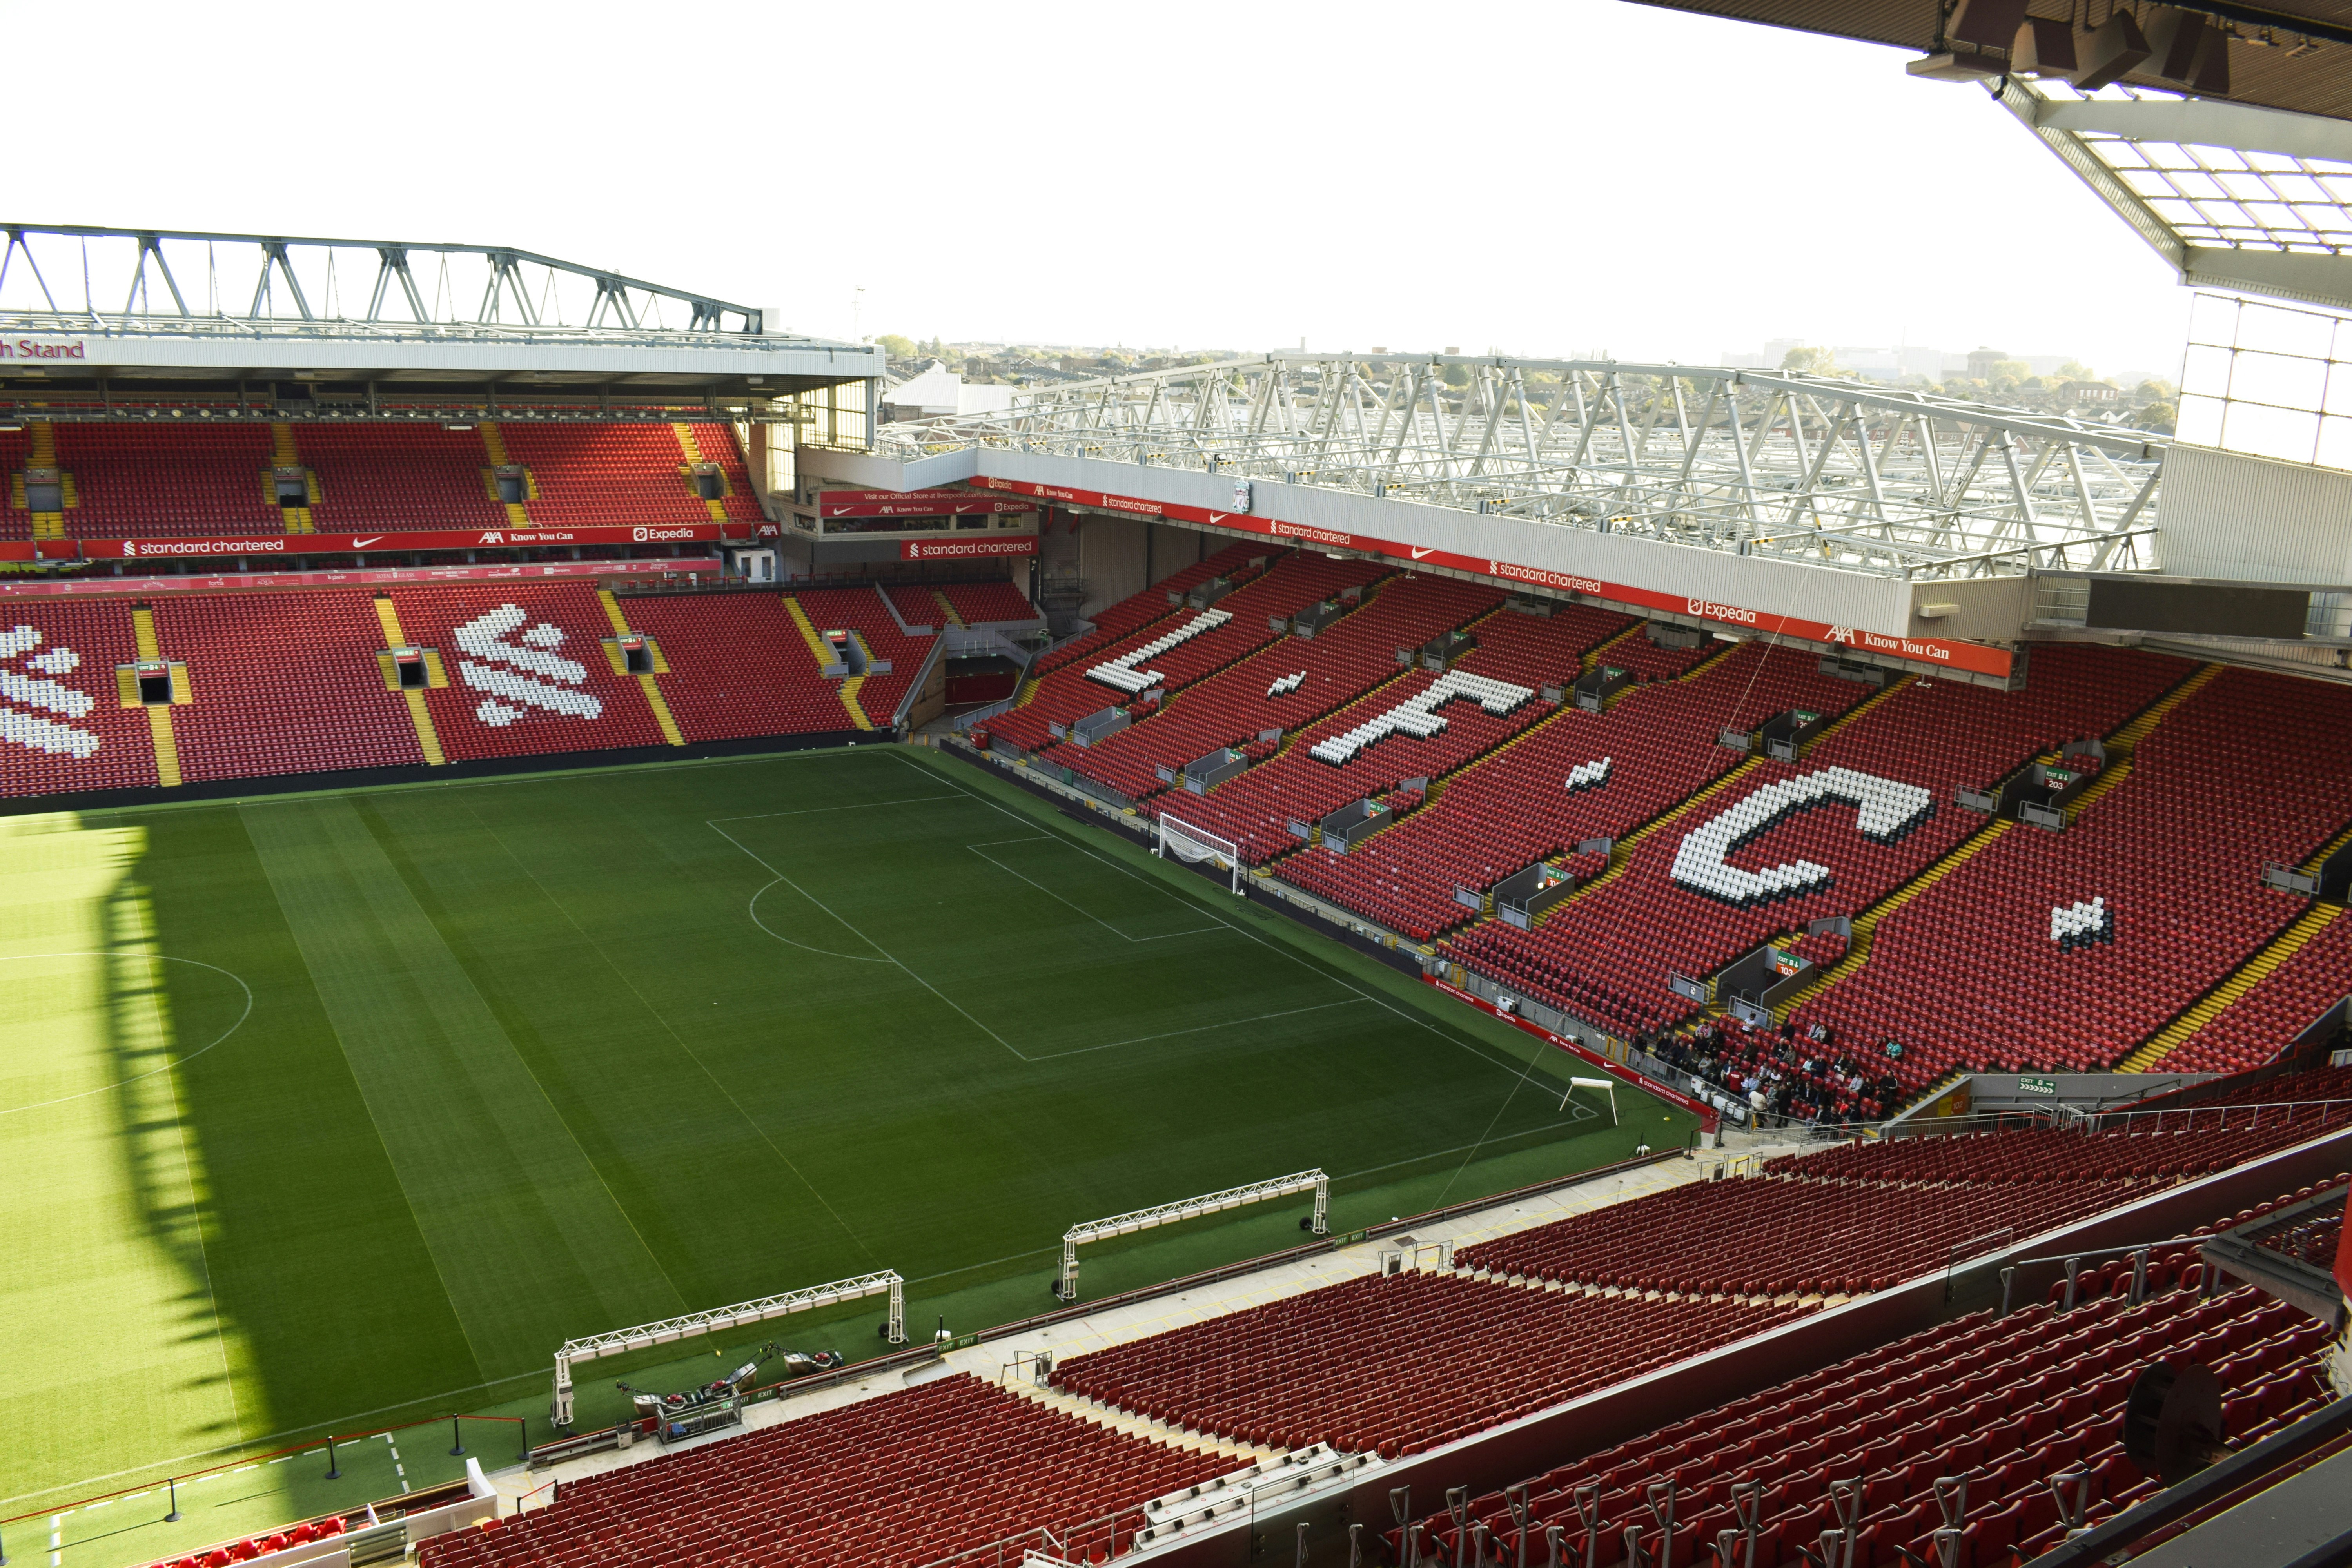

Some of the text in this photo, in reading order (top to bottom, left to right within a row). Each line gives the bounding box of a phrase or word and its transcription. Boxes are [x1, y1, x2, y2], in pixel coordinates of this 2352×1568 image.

[19, 339, 85, 359] Stand
[995, 479, 1012, 490] Expedia
[1034, 485, 1044, 496] AXA
[1109, 497, 1162, 514] standard chartered
[649, 528, 693, 541] Expedia
[757, 525, 779, 536] AXA
[1278, 524, 1350, 545] standard chartered
[478, 532, 504, 544] AXA
[140, 539, 284, 554] standard chartered
[922, 541, 1032, 555] standard chartered
[1500, 563, 1601, 593] standard chartered
[1705, 601, 1756, 623] Expedia
[1824, 626, 1949, 660] AXA Know You Can
[2049, 780, 2063, 790] 203
[1781, 966, 1793, 976] 103
[1439, 983, 1474, 1002] standard chartered
[1501, 1012, 1516, 1023] Expedia
[1644, 1080, 1689, 1105] standard chartered
[1953, 1100, 1964, 1111] 102
[1336, 1237, 1347, 1245] EXIT
[1352, 1232, 1363, 1241] EXIT
[938, 1342, 953, 1352] EXIT
[960, 1337, 975, 1347] EXIT
[757, 1389, 773, 1399] EXIT
